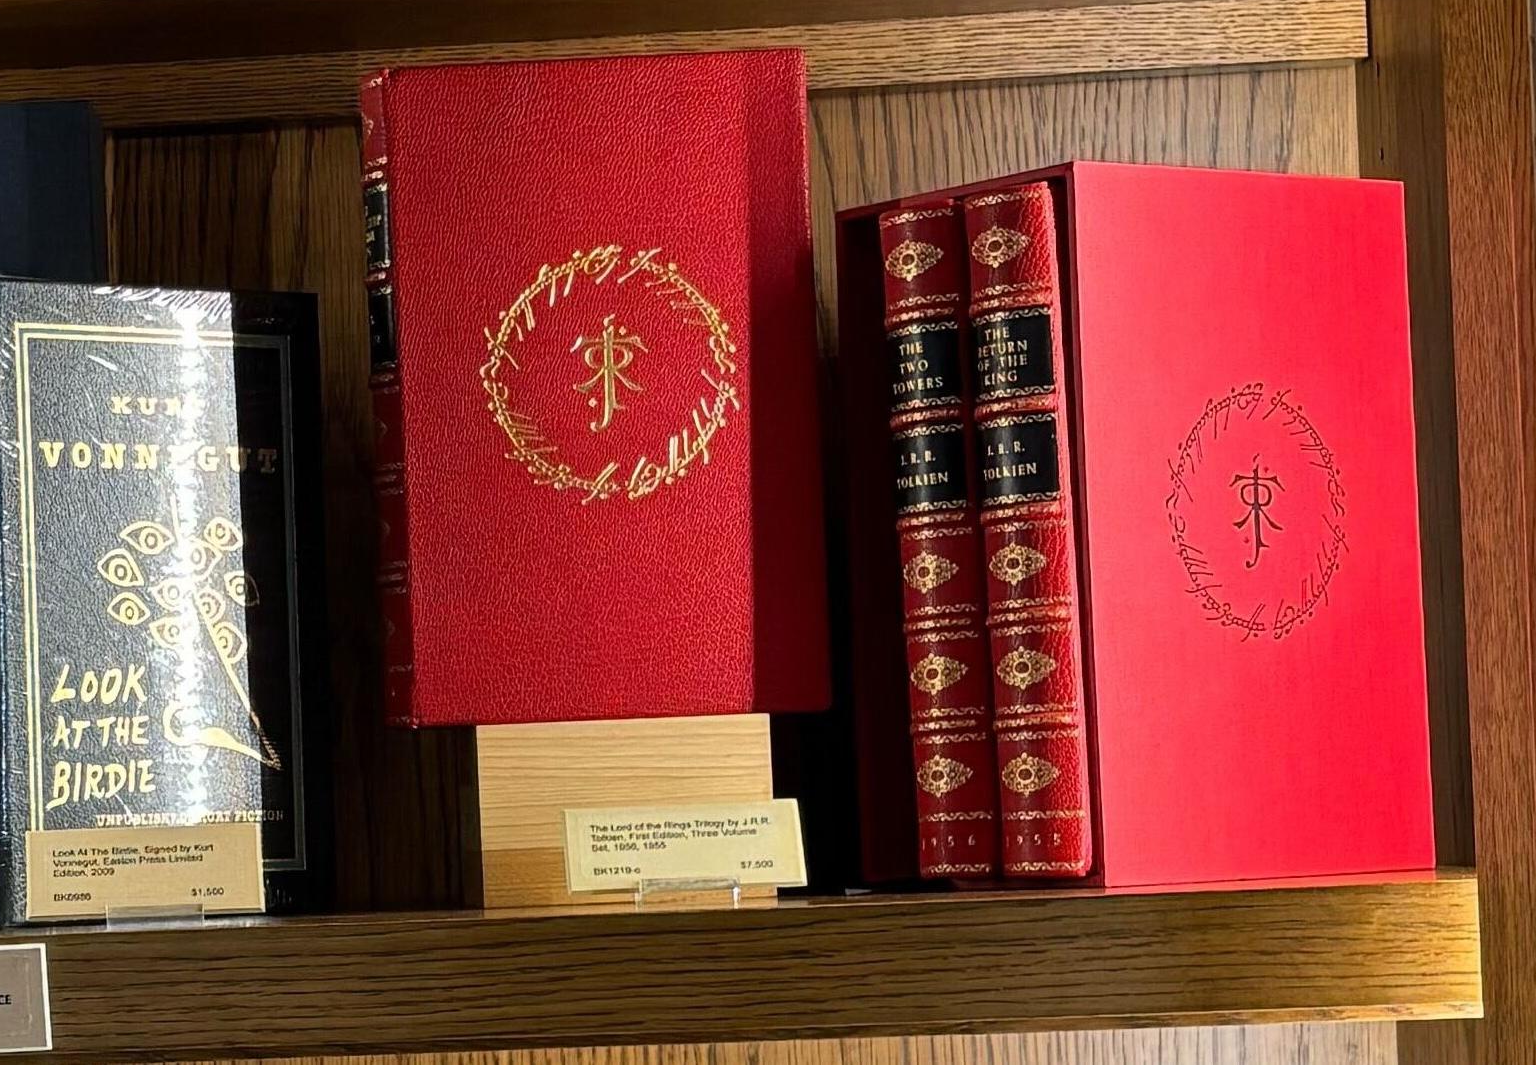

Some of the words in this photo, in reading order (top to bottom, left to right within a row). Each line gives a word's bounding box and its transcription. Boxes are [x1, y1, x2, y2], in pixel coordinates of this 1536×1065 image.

[985, 326, 1010, 341] THE
[899, 340, 924, 356] THE
[899, 360, 929, 375] TWO
[978, 360, 990, 372] OF
[999, 354, 1028, 367] THE
[892, 376, 944, 395] TOWERS
[984, 370, 1018, 386] KING
[998, 443, 1009, 454] R.
[1013, 441, 1025, 453] R.
[910, 452, 921, 464] R.
[924, 450, 936, 462] R.
[983, 462, 1037, 481] TOLKIEN
[896, 471, 949, 490] TOLKIEN
[50, 663, 148, 704] LOOK
[52, 715, 90, 750] AT
[96, 715, 150, 748] THE
[45, 758, 156, 812] BIRDIE
[590, 824, 609, 832] The
[610, 823, 632, 832] Lord
[922, 834, 976, 851] 1956
[52, 849, 75, 858] Look
